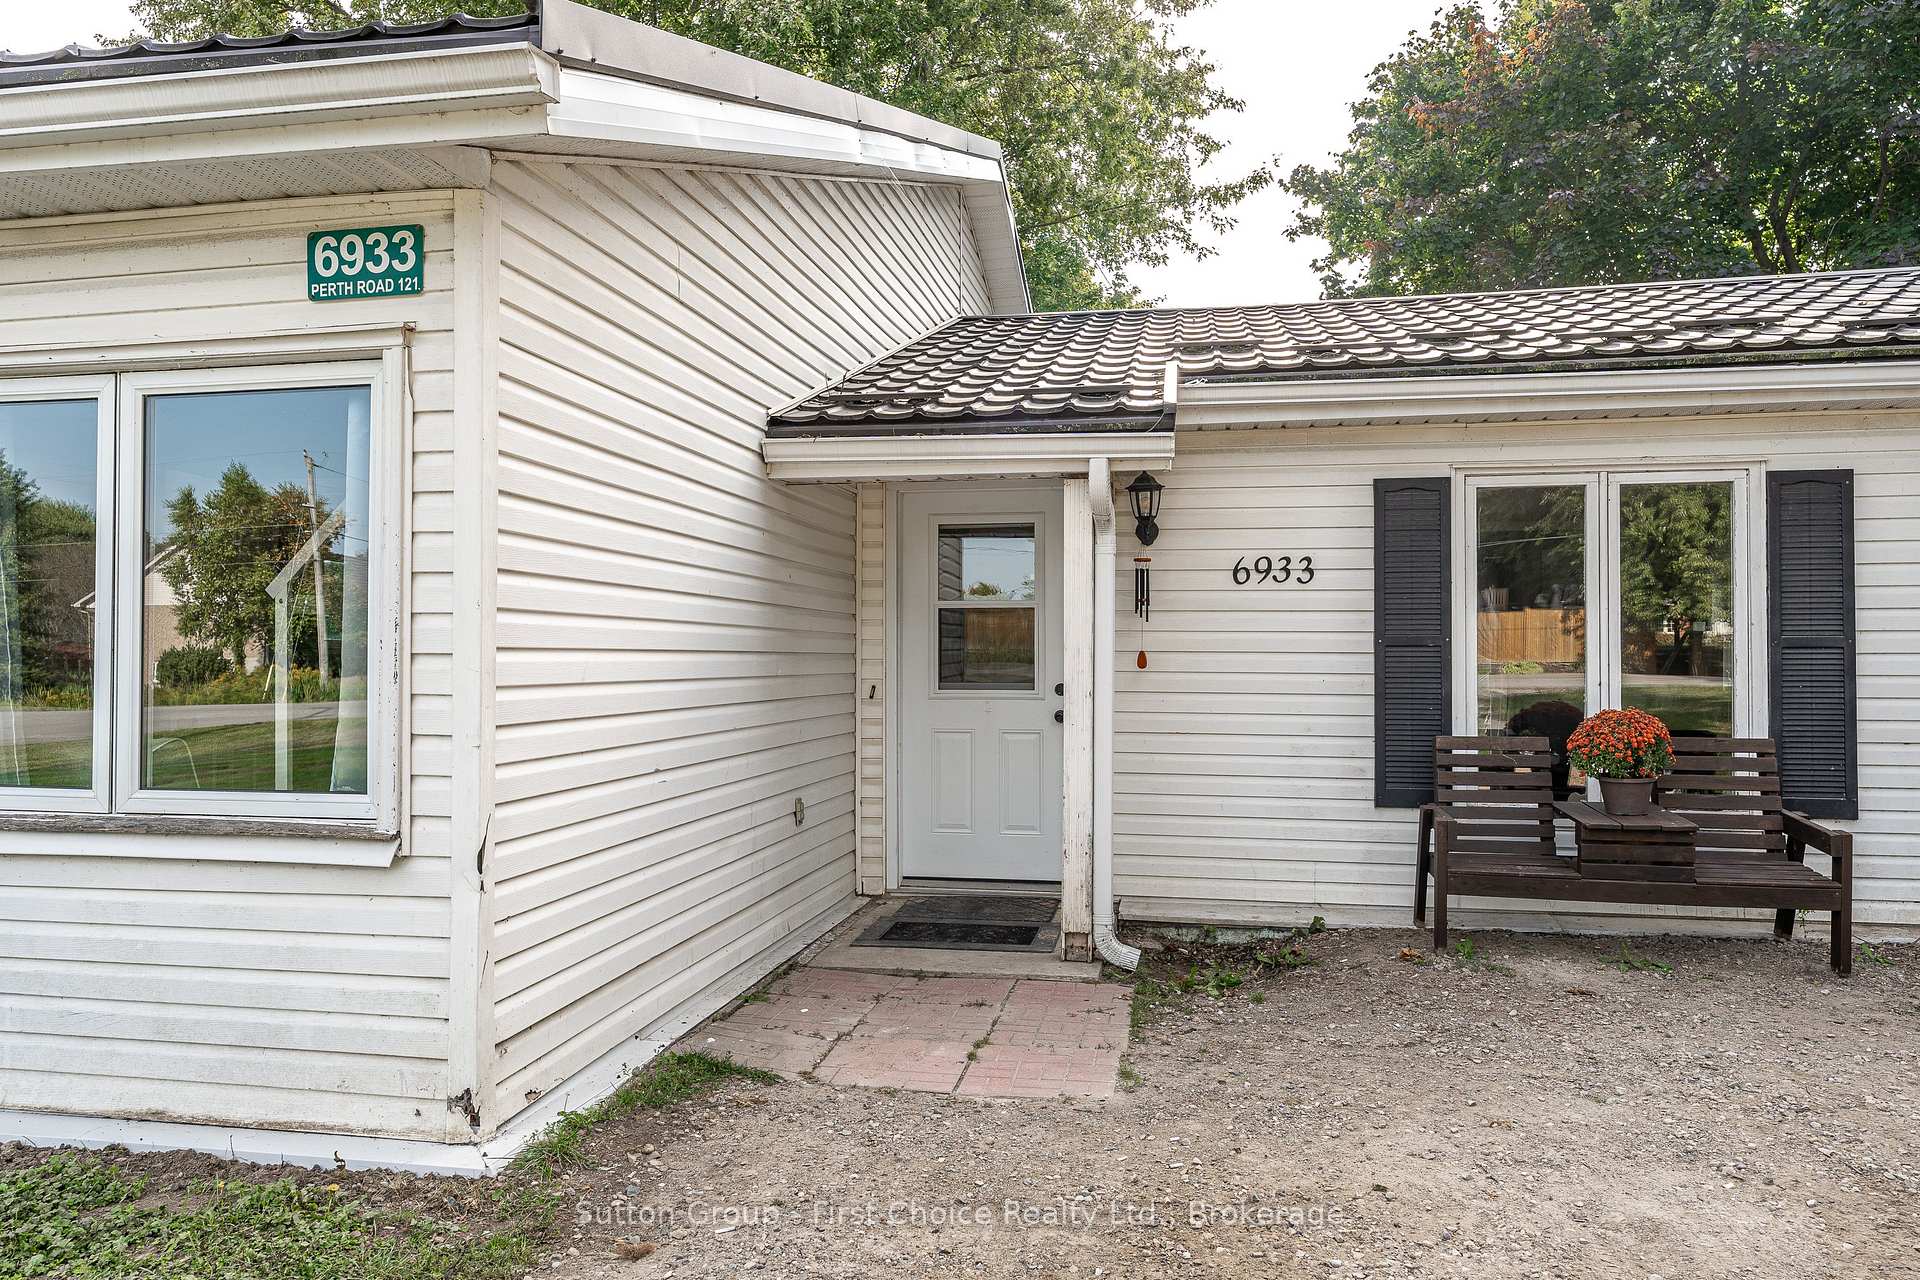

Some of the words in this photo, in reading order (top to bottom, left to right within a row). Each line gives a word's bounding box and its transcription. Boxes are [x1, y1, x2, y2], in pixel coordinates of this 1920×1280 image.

[315, 230, 416, 277] 6933
[311, 281, 353, 297] PERTH
[357, 278, 394, 294] ROAD
[1232, 555, 1315, 585] 6933
